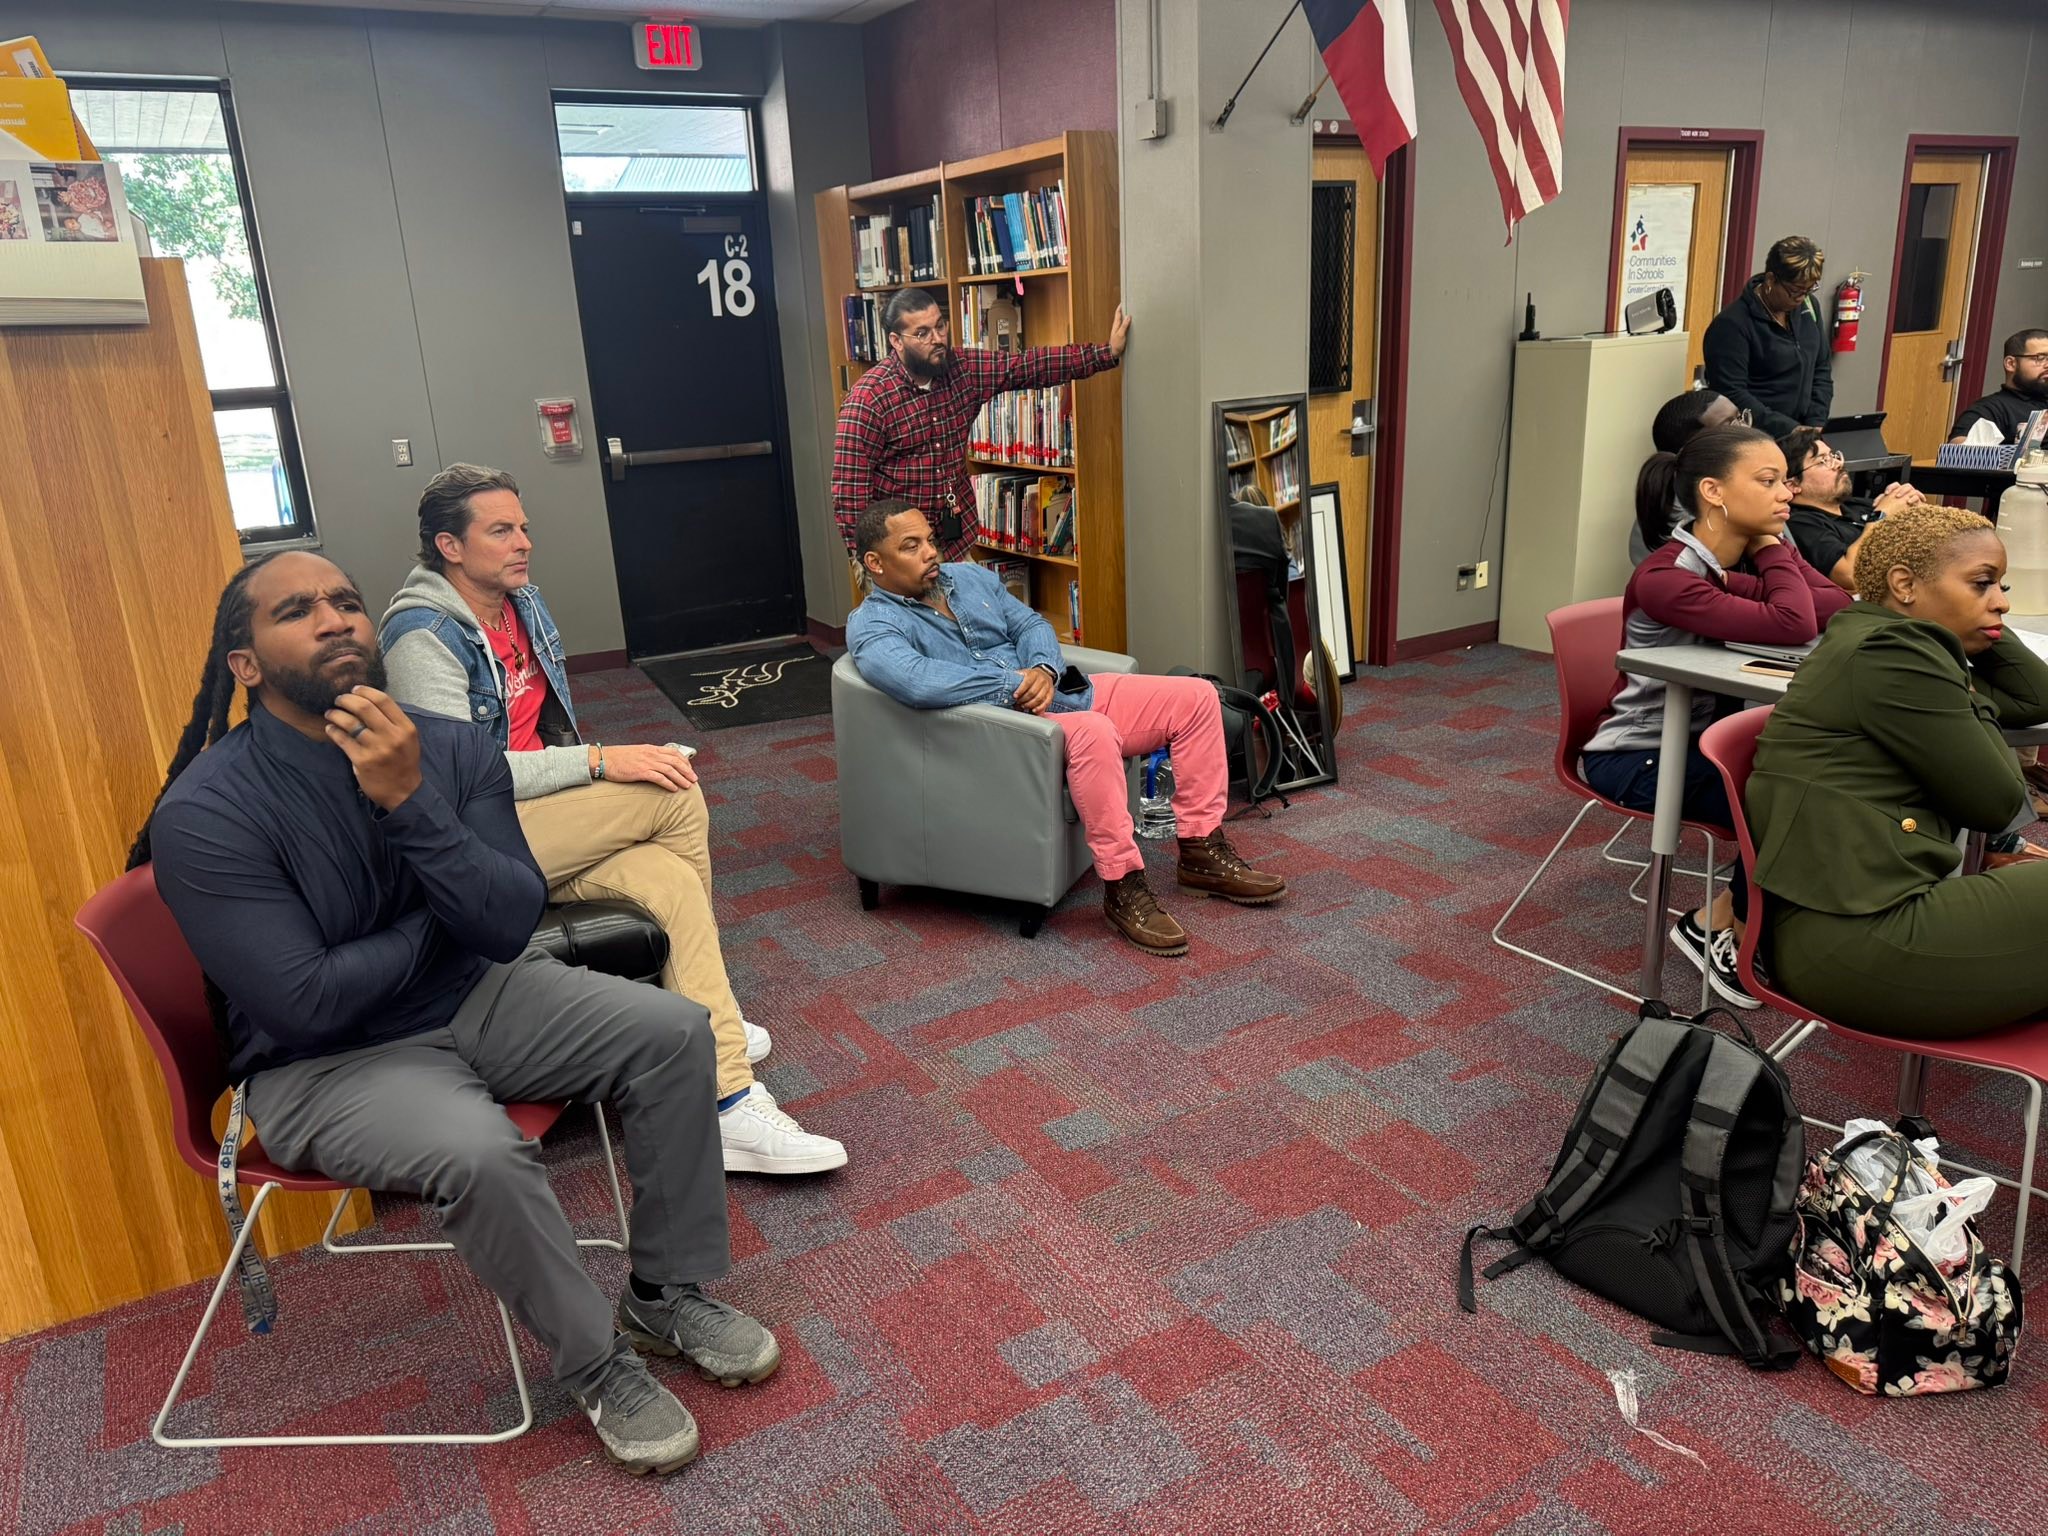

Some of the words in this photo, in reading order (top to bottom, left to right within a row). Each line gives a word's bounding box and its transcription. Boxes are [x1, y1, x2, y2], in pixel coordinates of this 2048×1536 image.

[646, 24, 693, 67] EXIT
[724, 234, 749, 258] C-2
[1629, 255, 1677, 267] Communities
[1628, 268, 1636, 281] In
[1636, 267, 1665, 280] Schools
[697, 258, 756, 317] 18
